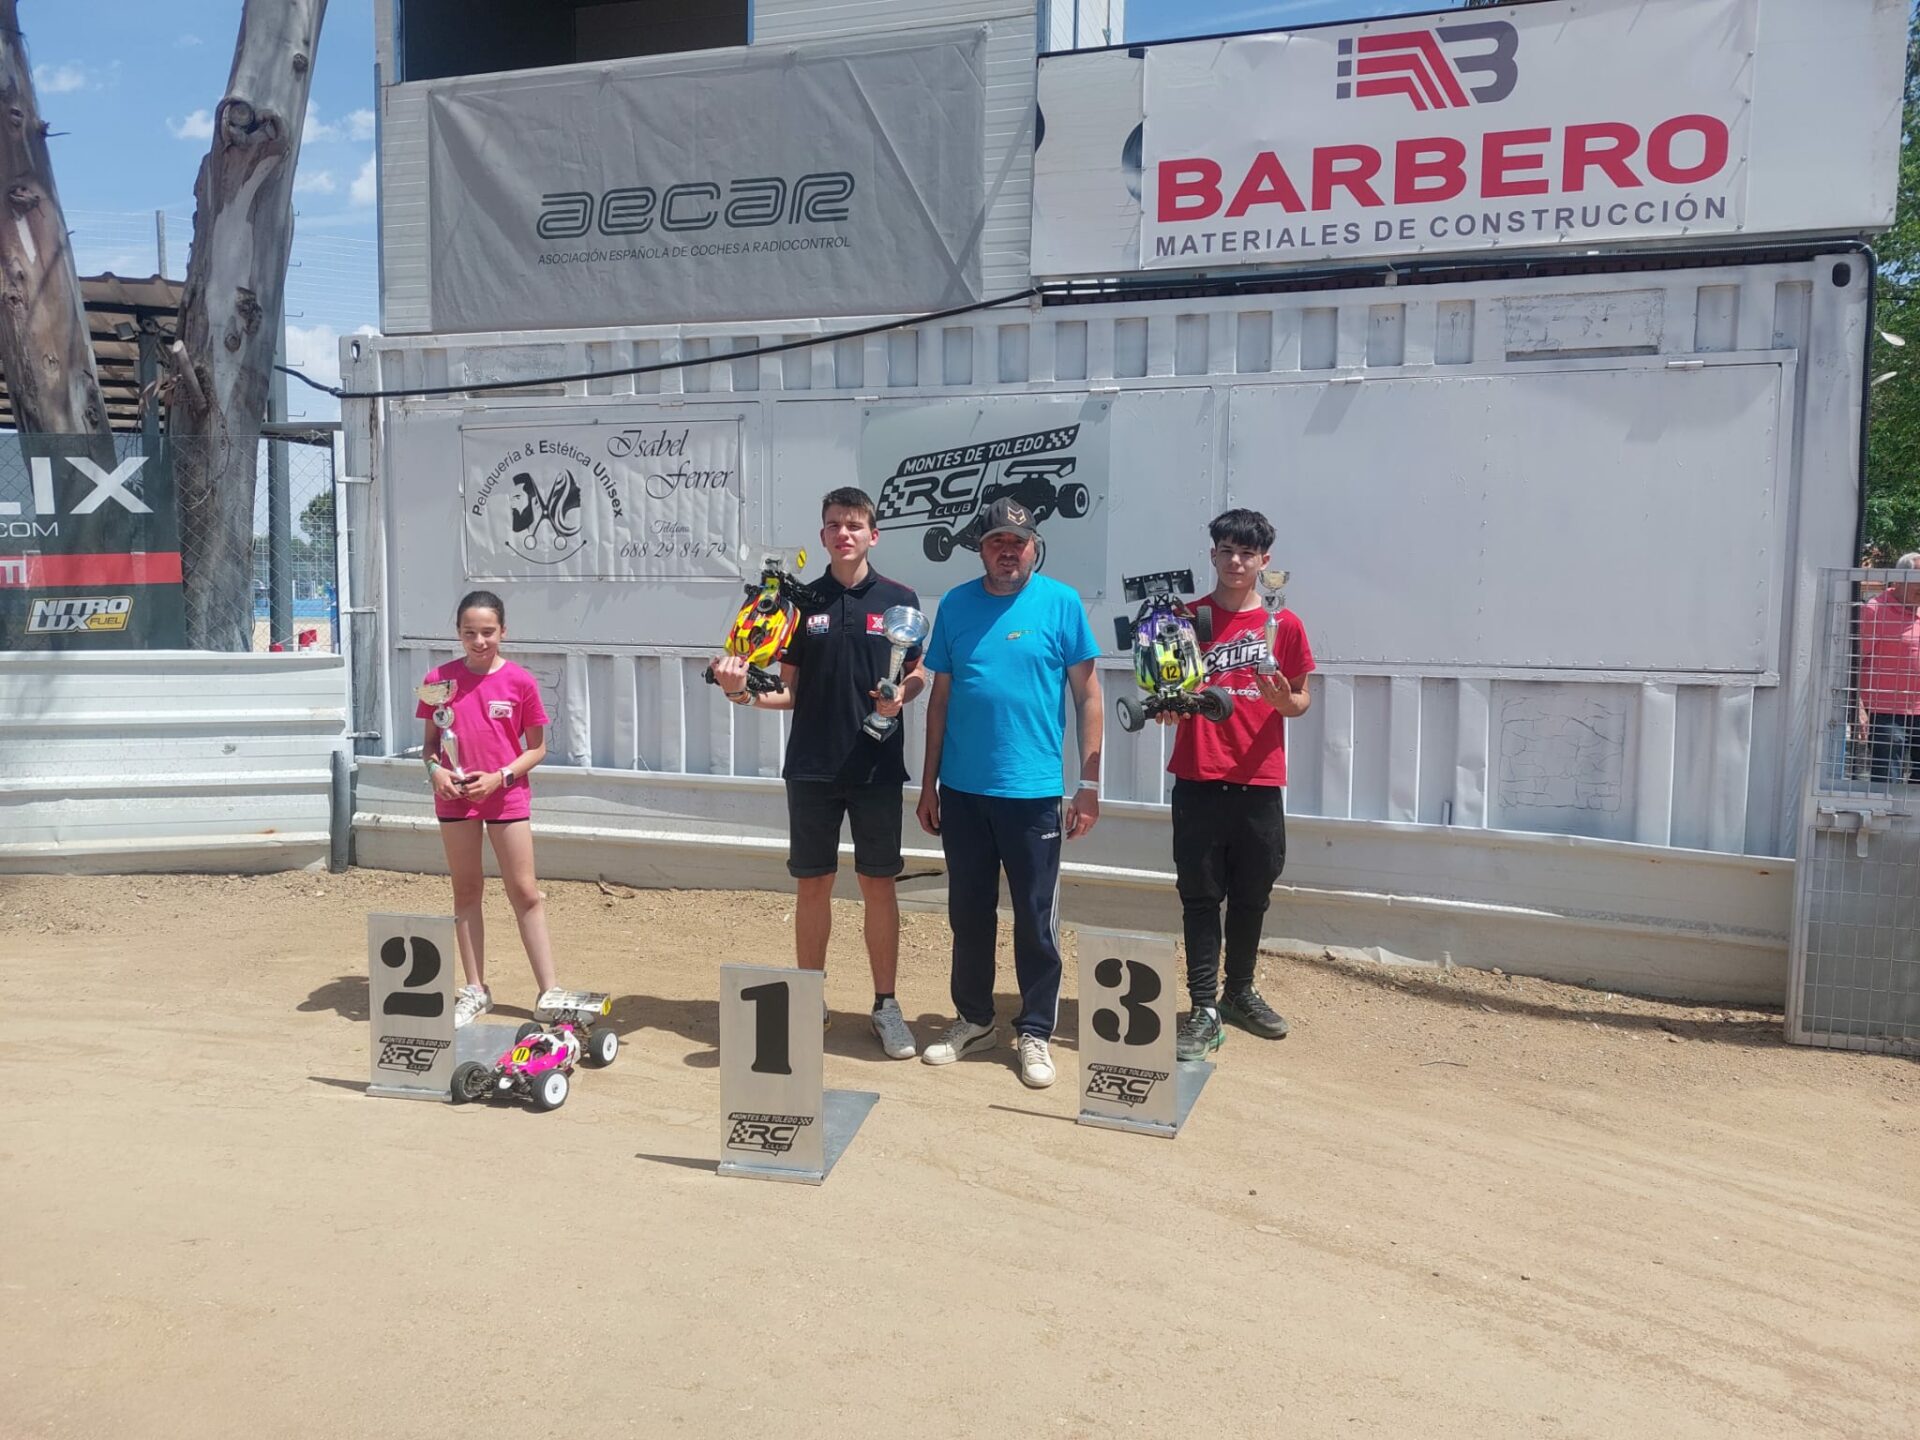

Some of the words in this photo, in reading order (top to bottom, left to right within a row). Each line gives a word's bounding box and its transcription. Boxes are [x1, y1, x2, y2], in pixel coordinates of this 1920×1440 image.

[1157, 114, 1729, 223] BARBERO
[1155, 222, 1361, 257] MATERIALES
[1374, 218, 1416, 242] DE
[1429, 193, 1727, 238] CONSTRUCCIÓN
[537, 249, 607, 265] ASOCIACIÓN
[609, 246, 669, 261] ESPAÑOLA
[672, 245, 688, 257] DE
[690, 242, 740, 256] COCHES
[741, 242, 751, 253] A
[752, 236, 850, 252] RADIOCONTROL
[606, 429, 689, 458] Isabel
[904, 450, 961, 475] MONTES
[965, 446, 986, 462] DE
[989, 435, 1045, 459] TOLEDO
[472, 450, 522, 517] Peluquería
[524, 443, 535, 457] &
[539, 440, 591, 468] Estética
[592, 461, 623, 518] Unisex
[646, 460, 734, 499] Ferrer
[903, 468, 980, 507] RC
[935, 503, 971, 517] CLUB
[621, 541, 649, 558] 688
[655, 541, 675, 558] 29
[680, 541, 700, 558] 84
[706, 541, 727, 558] 79
[31, 599, 131, 616] NITRO
[28, 613, 91, 632] LUX
[89, 616, 122, 626] FUEL
[1165, 665, 1178, 679] 12
[379, 936, 445, 1018] 2
[1092, 958, 1162, 1046] 3
[739, 981, 793, 1075] 1
[395, 1046, 435, 1062] RC
[1105, 1075, 1150, 1094] RC
[748, 1124, 794, 1142] RC
[765, 1143, 789, 1151] CLUB
